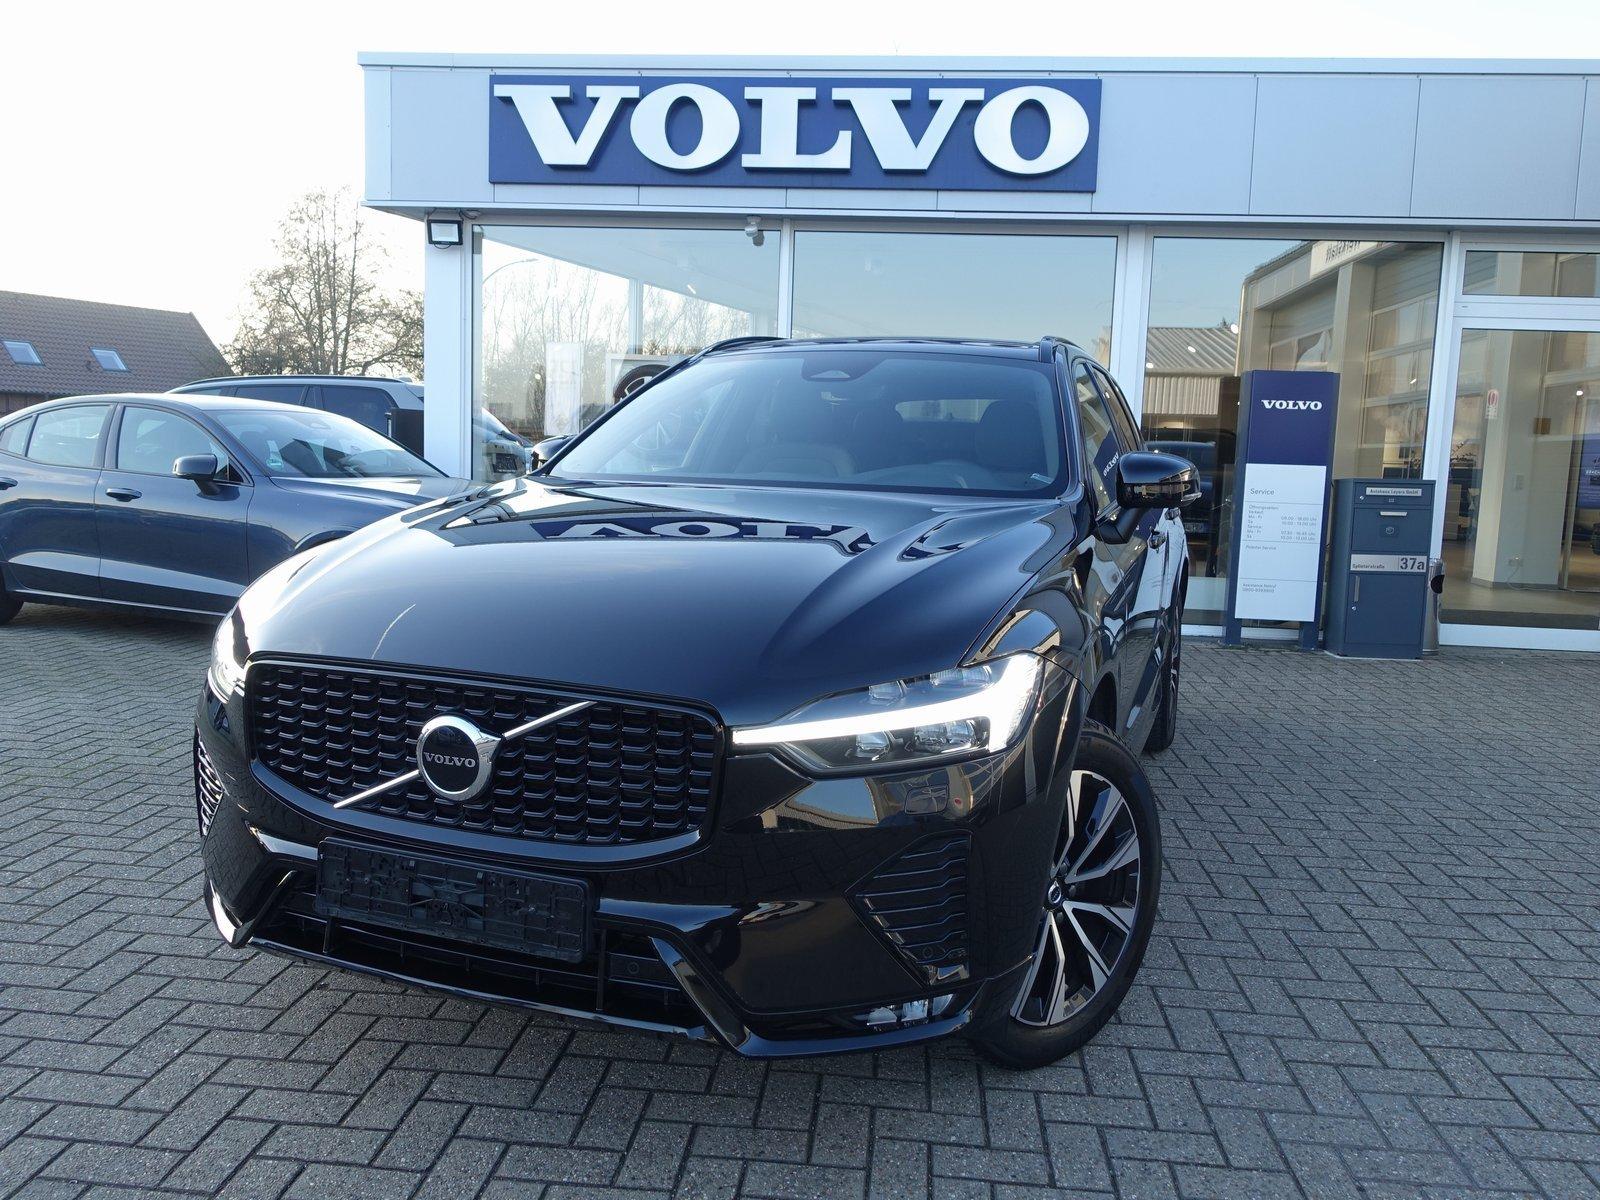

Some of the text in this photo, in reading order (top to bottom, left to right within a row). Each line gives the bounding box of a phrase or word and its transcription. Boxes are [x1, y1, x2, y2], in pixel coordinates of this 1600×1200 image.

[494, 82, 1090, 176] VOLVO
[1261, 399, 1323, 411] VOLVO
[1250, 488, 1275, 496] Service
[1400, 557, 1425, 570] 37a
[423, 752, 476, 769] VOLVO
